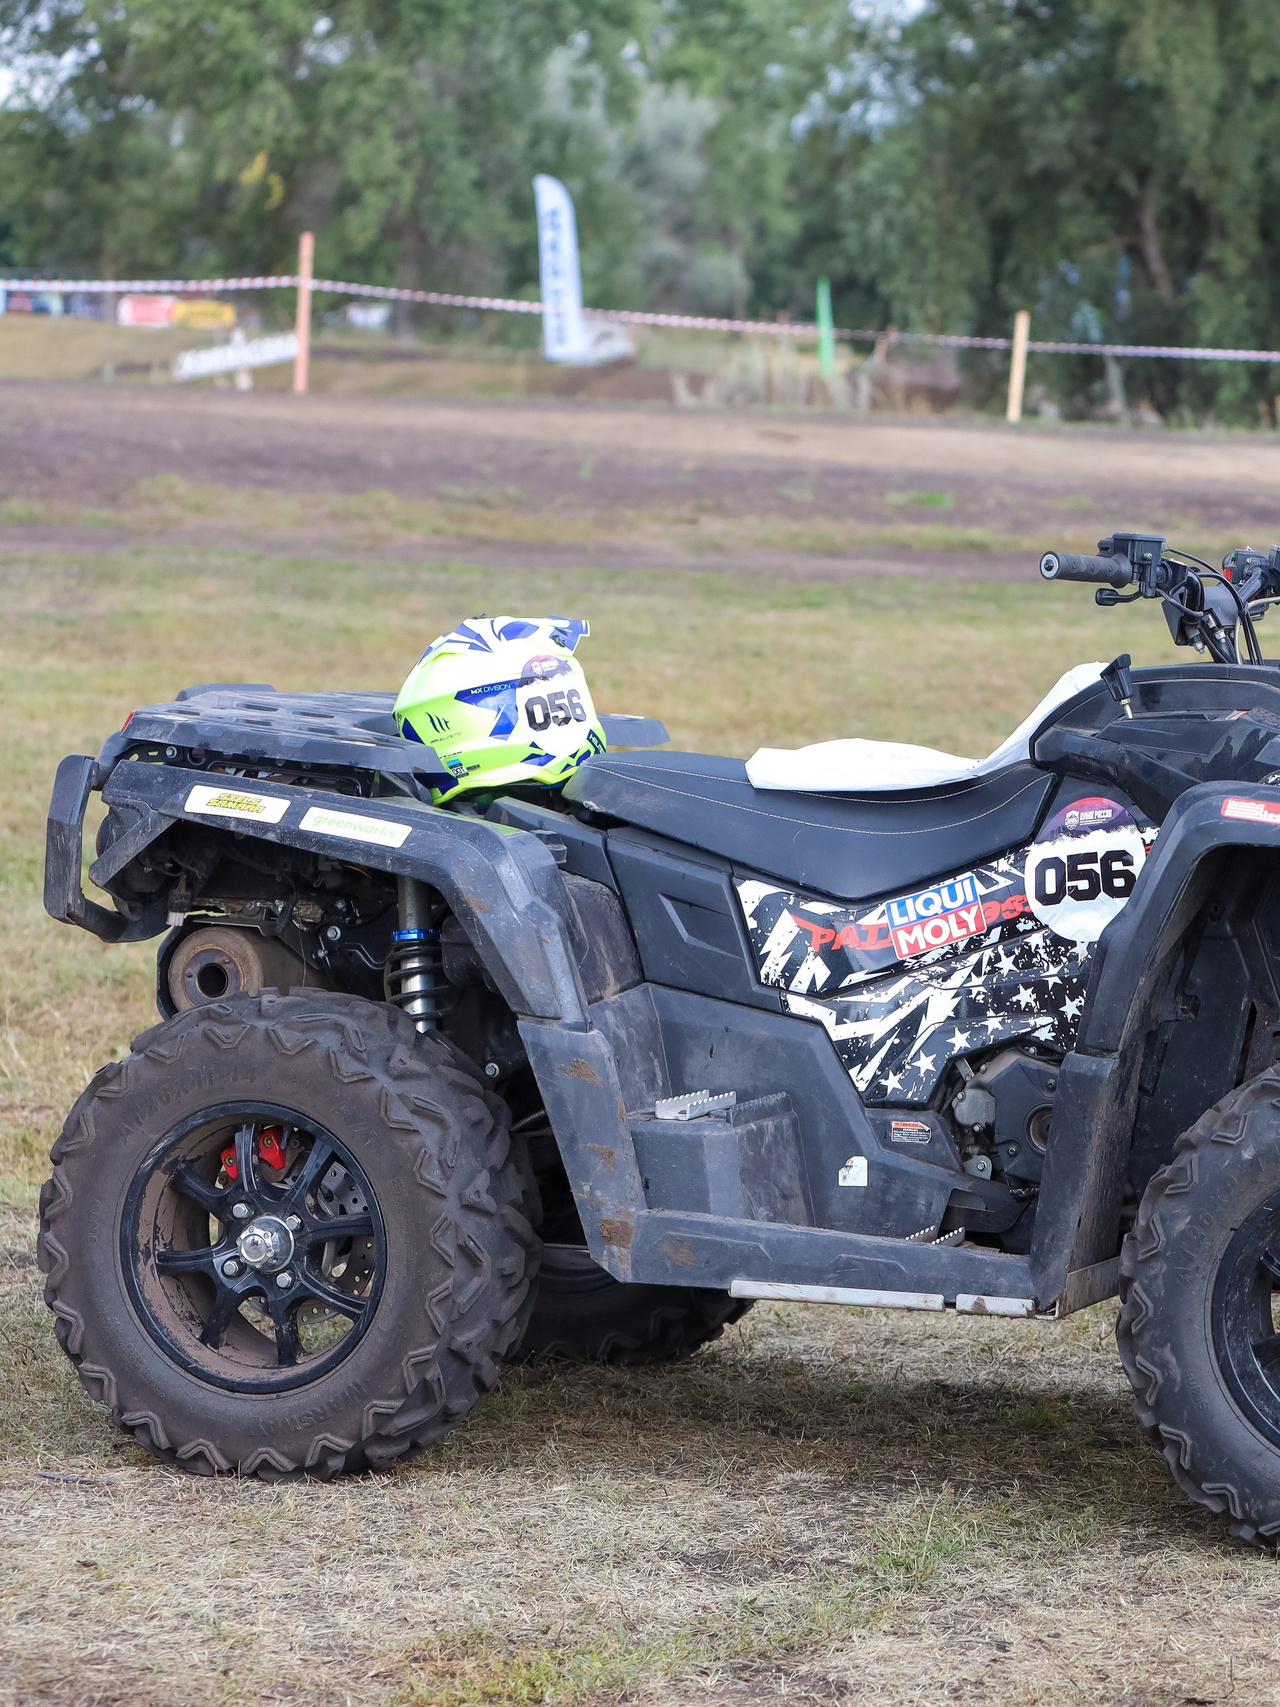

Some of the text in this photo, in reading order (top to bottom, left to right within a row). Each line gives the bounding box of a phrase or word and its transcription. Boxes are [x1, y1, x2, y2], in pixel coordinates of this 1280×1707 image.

[483, 683, 511, 693] DIVISION
[524, 688, 587, 732] 056
[216, 792, 262, 805] STELS
[311, 815, 397, 839] greenworks
[1034, 849, 1137, 907] 056
[887, 876, 976, 926] LIQUI
[896, 904, 981, 956] MOLY
